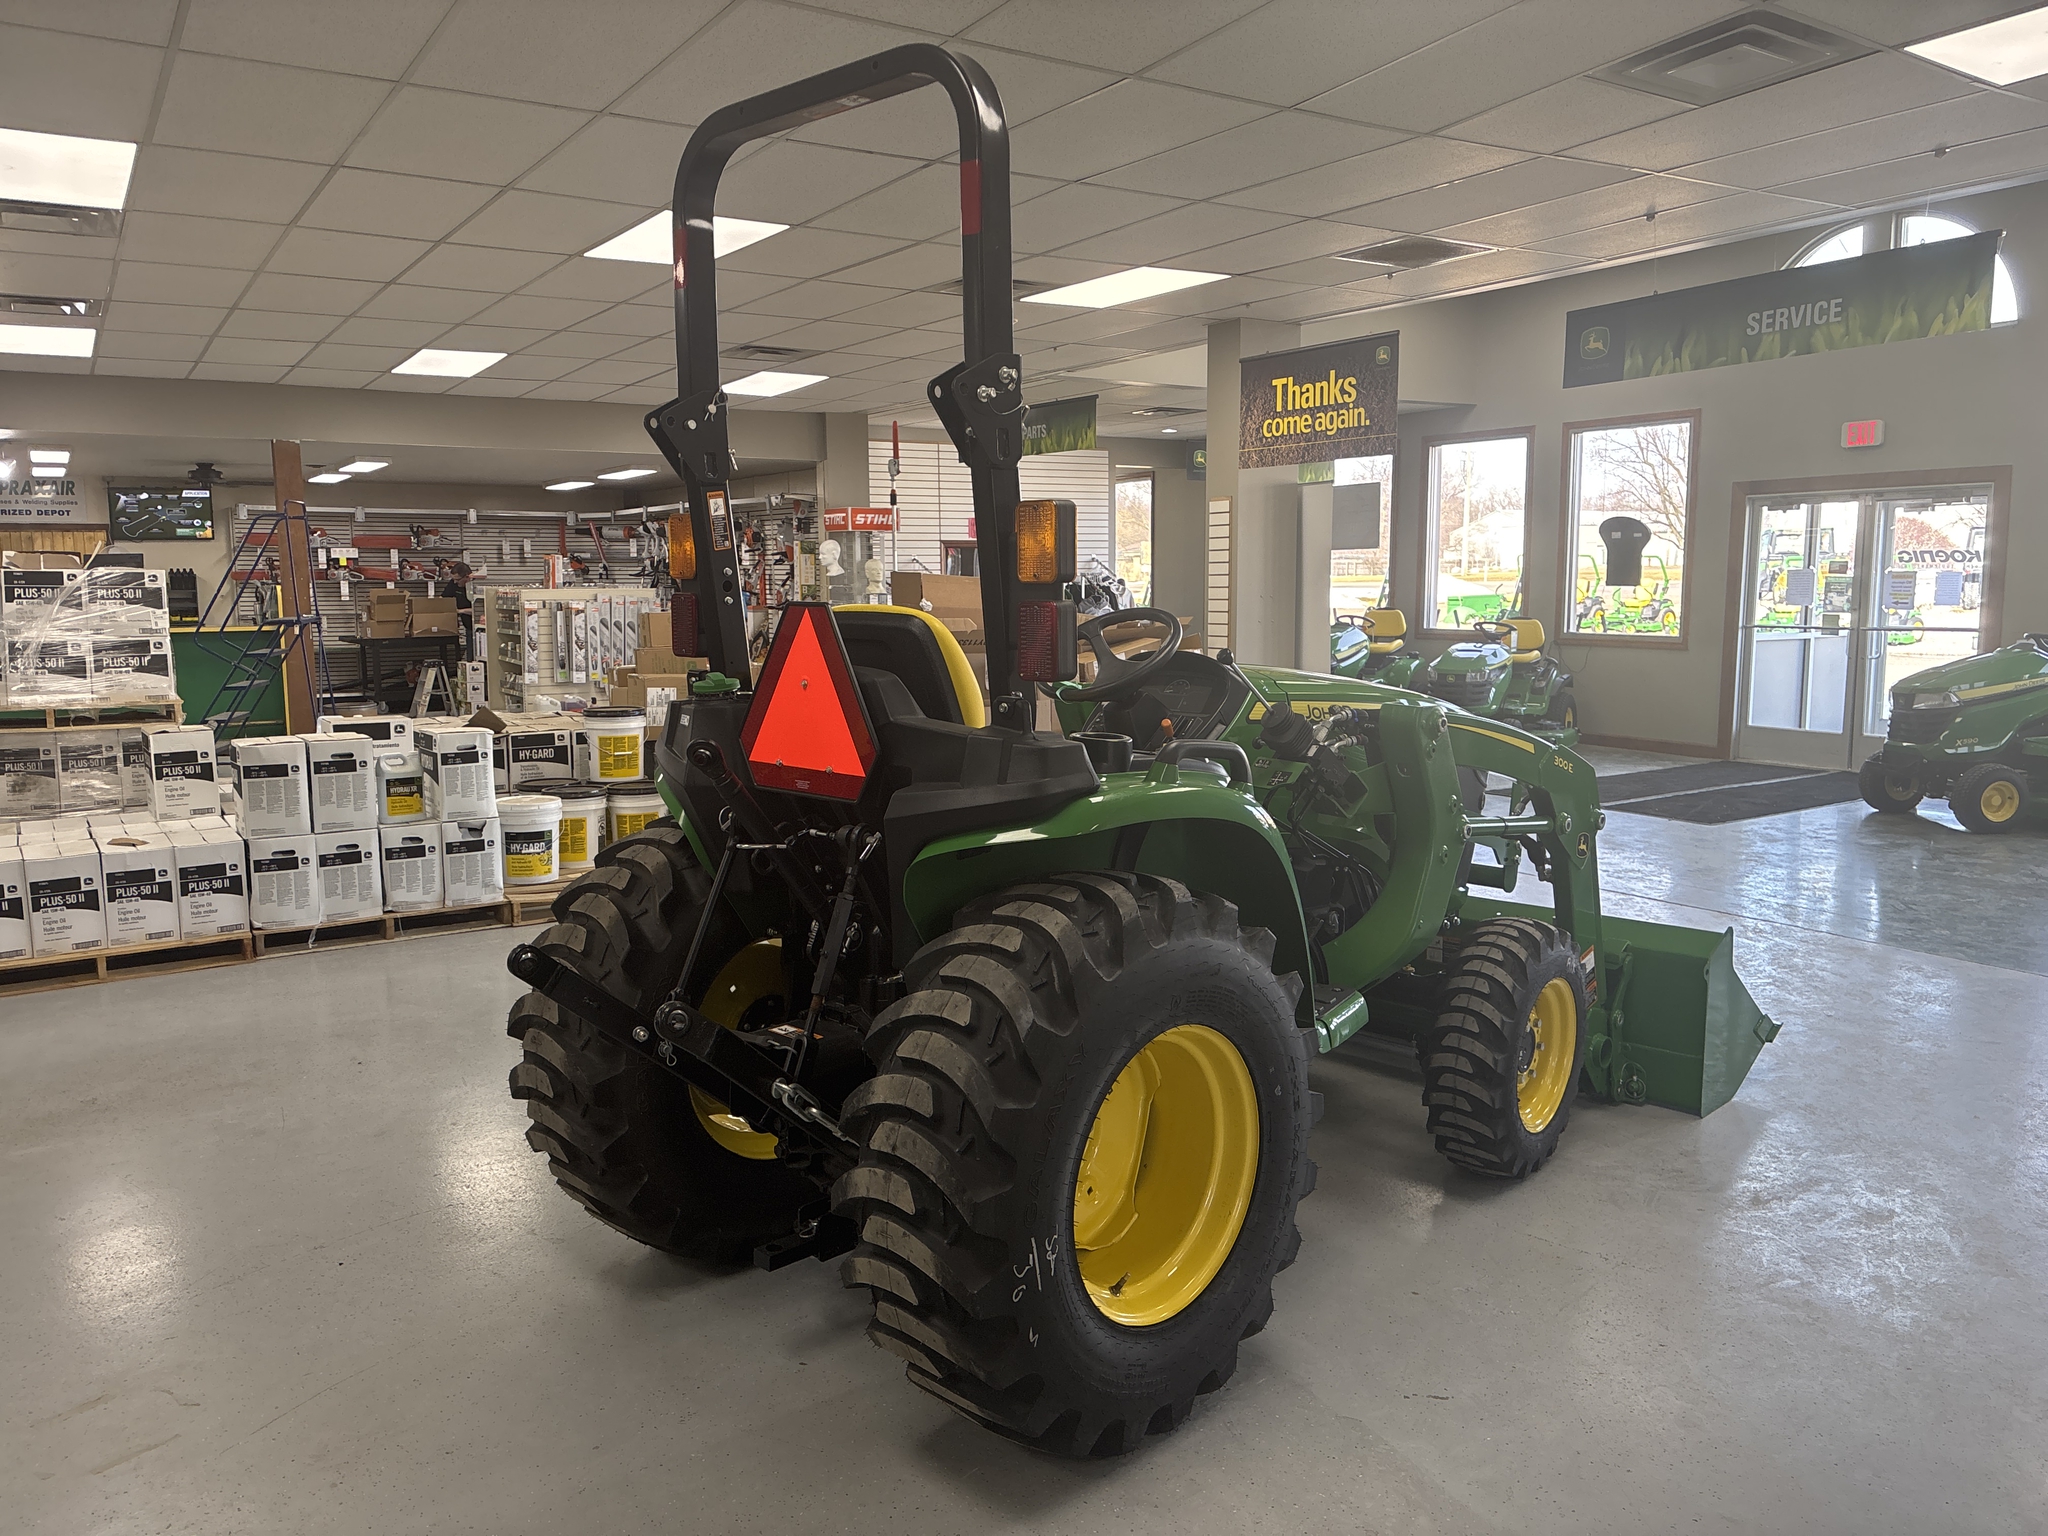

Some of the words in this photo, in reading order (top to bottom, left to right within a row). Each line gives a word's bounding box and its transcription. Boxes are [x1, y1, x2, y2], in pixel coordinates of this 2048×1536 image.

[1746, 298, 1843, 337] SERVICE
[1272, 370, 1357, 412] Thanks
[1263, 413, 1312, 438] come
[1315, 403, 1370, 436] again.
[1022, 424, 1047, 440] PARTS
[1847, 421, 1878, 446] EXIT
[36, 509, 71, 517] DEPOT
[855, 513, 893, 525] STIHL
[825, 514, 845, 526] STIHL
[14, 587, 51, 599] PLUS-50
[97, 588, 133, 599] PLUS-50
[103, 656, 139, 667] PLUS-50
[1306, 704, 1331, 720] JOH
[1955, 737, 1979, 747] X590
[519, 748, 555, 760] HY-GARD
[5, 762, 37, 772] PLUS-50
[69, 759, 99, 769] PLUS-50
[163, 765, 194, 776] PLUS-50
[195, 765, 202, 774] II
[390, 786, 411, 794] HYDRAU
[511, 842, 546, 853] HY-GARD
[116, 885, 151, 897] PLUS-50
[153, 884, 159, 893] II
[188, 879, 222, 891] PLUS-50
[224, 879, 230, 888] II
[2, 900, 9, 911] II
[40, 894, 77, 907] PLUS-50
[78, 893, 85, 903] II
